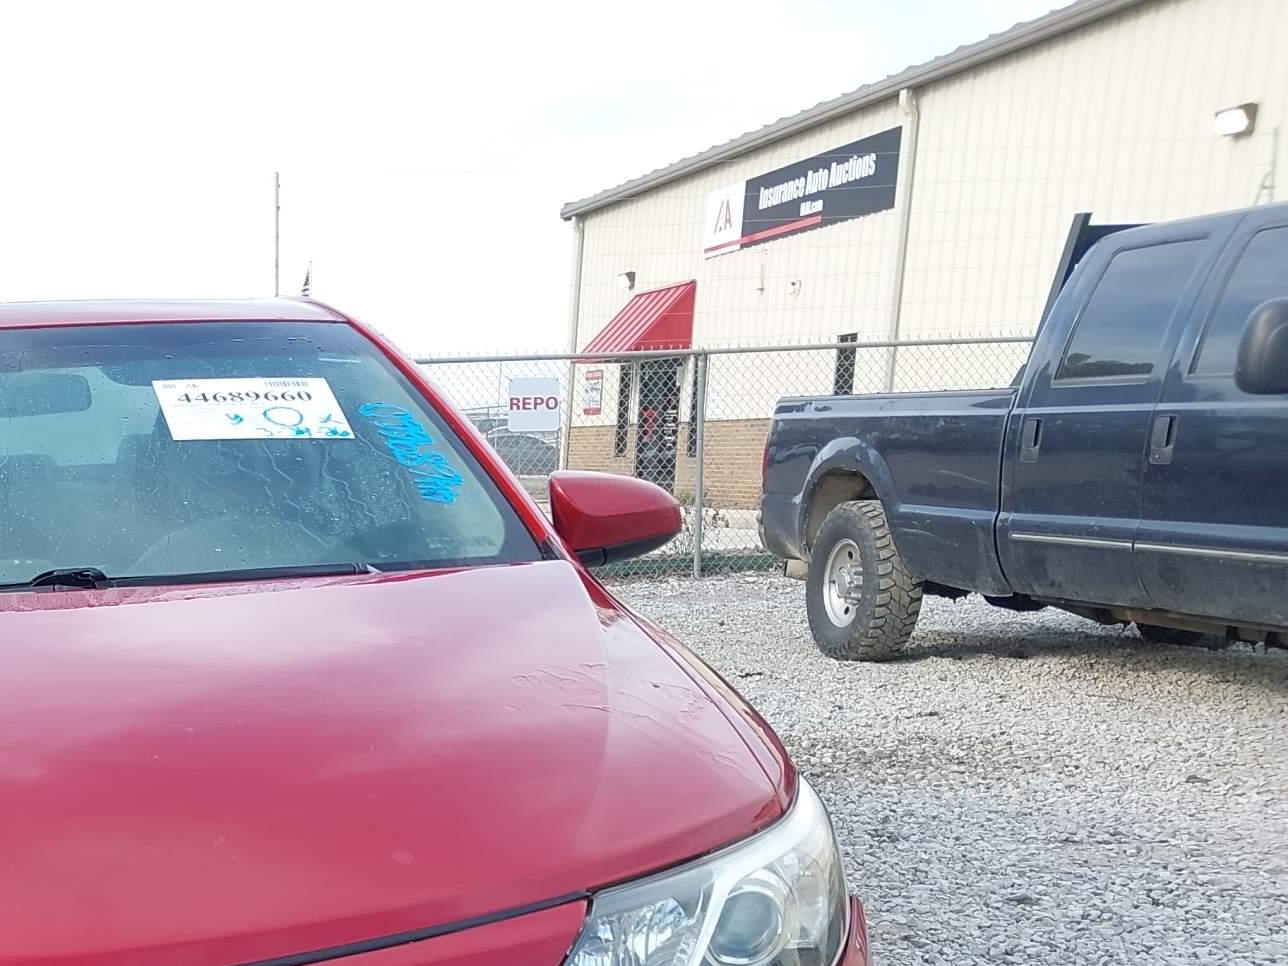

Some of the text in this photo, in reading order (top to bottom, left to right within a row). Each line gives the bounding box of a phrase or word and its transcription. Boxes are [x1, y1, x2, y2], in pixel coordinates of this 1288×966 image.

[758, 153, 876, 210] Insurance Auto Auctions
[177, 390, 313, 404] 44689660
[509, 396, 559, 411] REPO
